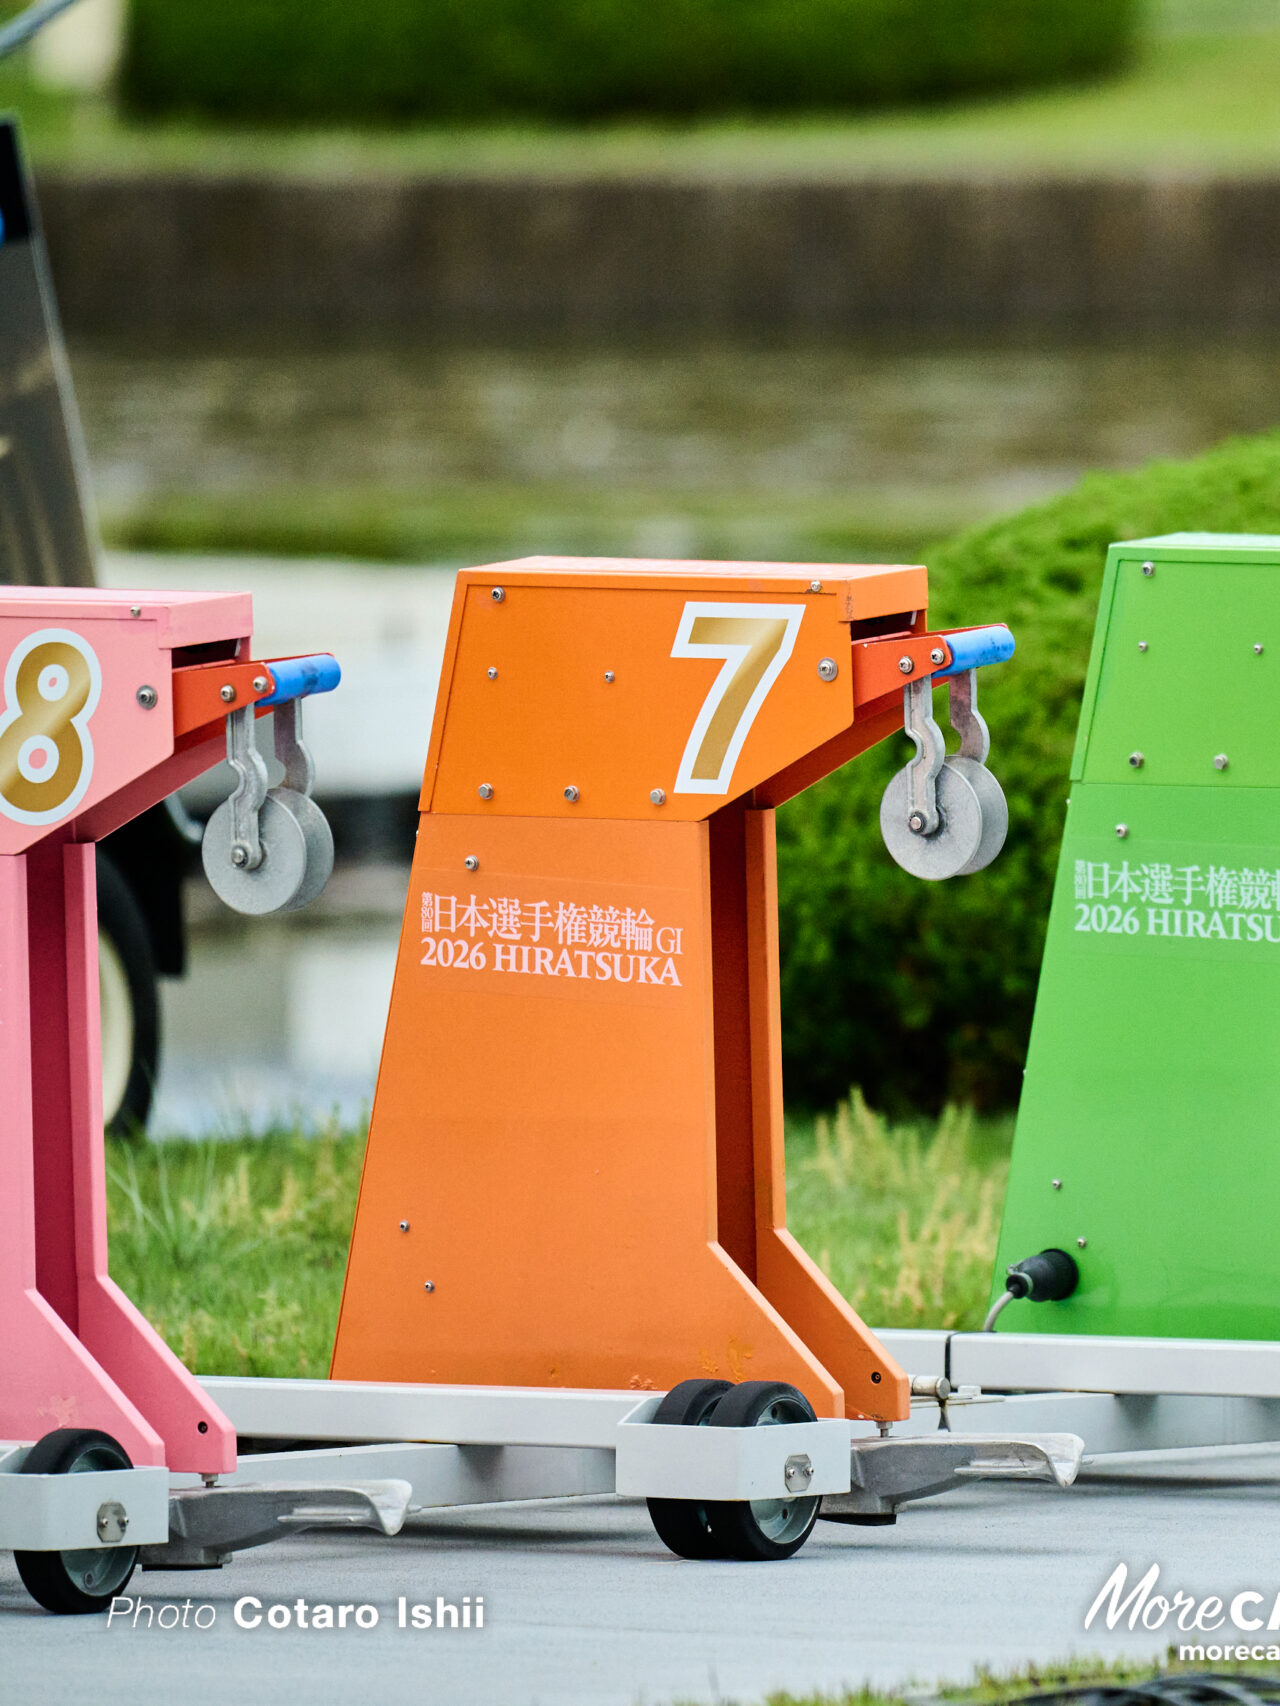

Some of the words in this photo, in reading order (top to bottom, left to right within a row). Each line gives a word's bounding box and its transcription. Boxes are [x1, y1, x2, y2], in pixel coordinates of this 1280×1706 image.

[0, 628, 102, 826] 8
[670, 601, 805, 795] 7
[420, 937, 487, 970] 2026
[492, 943, 683, 987] HIRATSUKA
[1074, 903, 1140, 935] 2026
